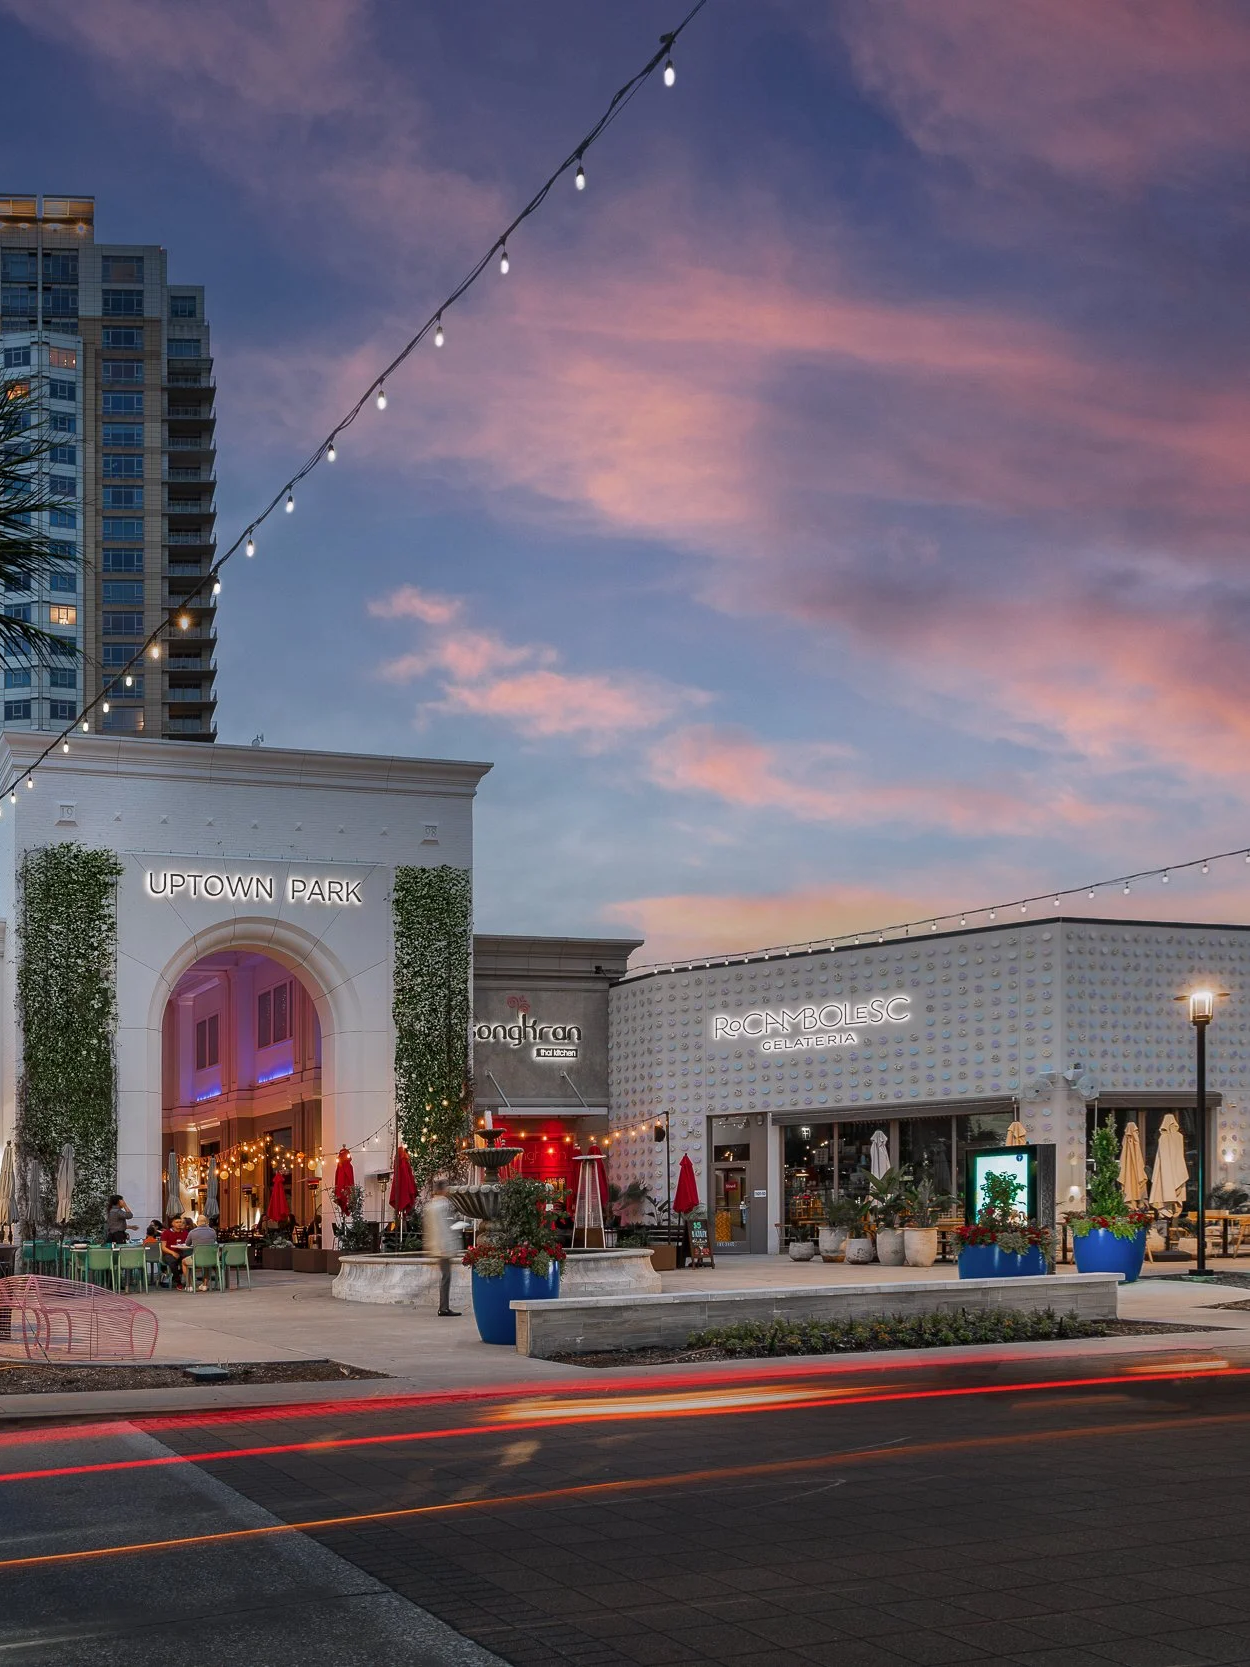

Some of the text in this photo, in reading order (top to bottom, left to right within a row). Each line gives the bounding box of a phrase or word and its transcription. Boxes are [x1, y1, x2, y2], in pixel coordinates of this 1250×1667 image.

[61, 807, 73, 819] 19
[149, 872, 363, 903] UPTOWN PARK
[762, 1033, 856, 1051] GELATERIA
[541, 1048, 576, 1057] thai kitchen
